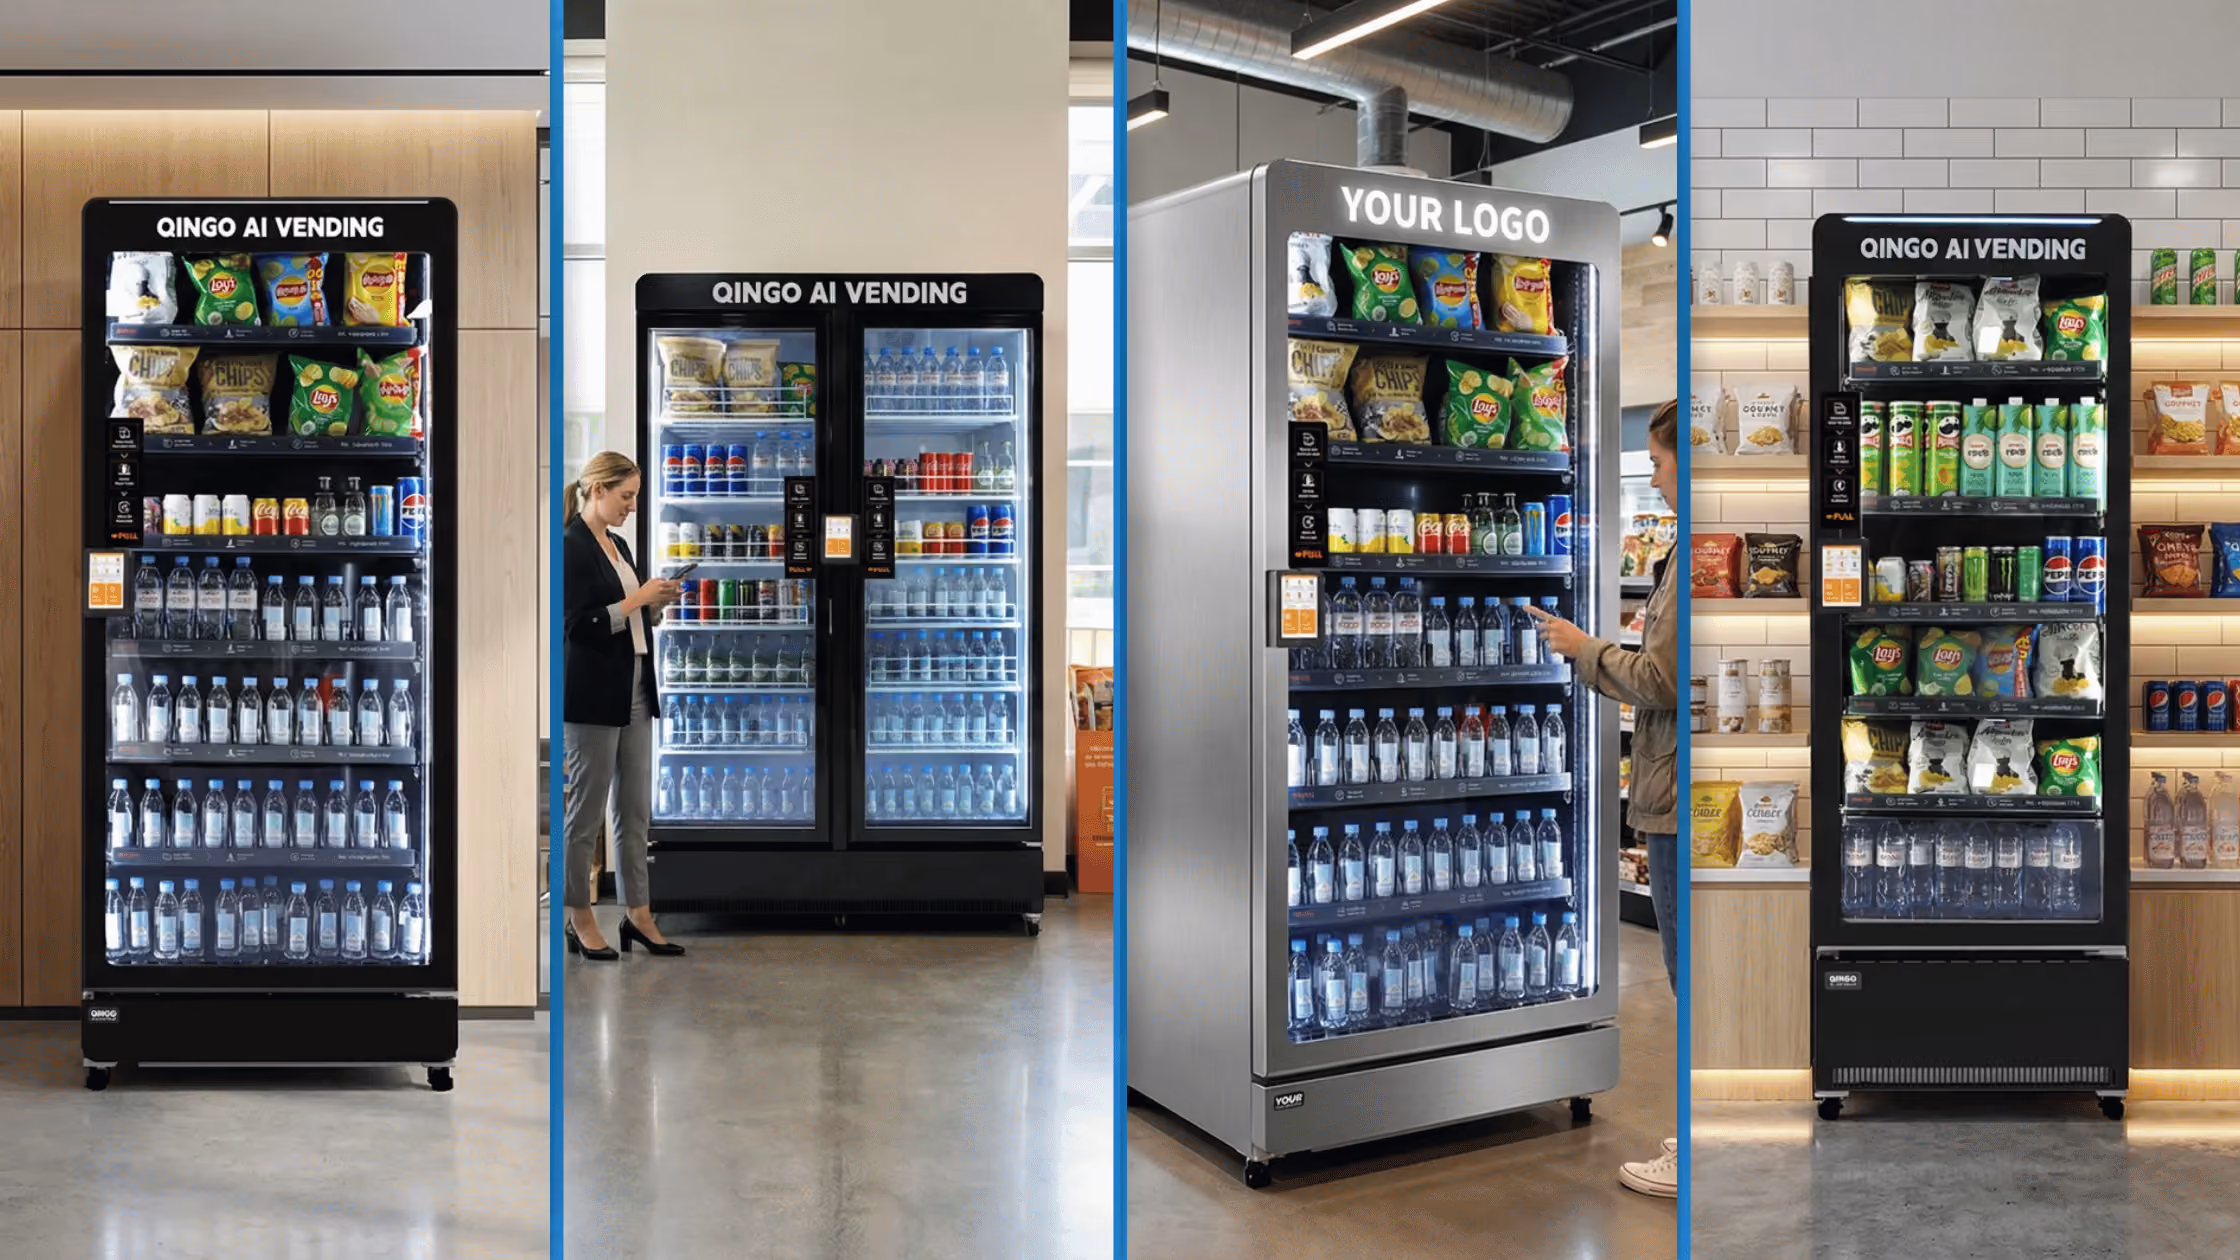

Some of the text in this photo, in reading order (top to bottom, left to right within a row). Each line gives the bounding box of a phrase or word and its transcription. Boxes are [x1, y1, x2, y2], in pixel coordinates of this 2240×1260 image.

[1341, 187, 1550, 244] YOUR LOGO
[157, 217, 384, 238] QINGO AI VENDING
[1861, 238, 2086, 260] QINGO AI VENDING
[713, 282, 967, 304] QINGO AI VENDING
[215, 366, 266, 387] CHIPS
[728, 362, 763, 381] CHIPS
[1275, 1092, 1303, 1106] YOUR
